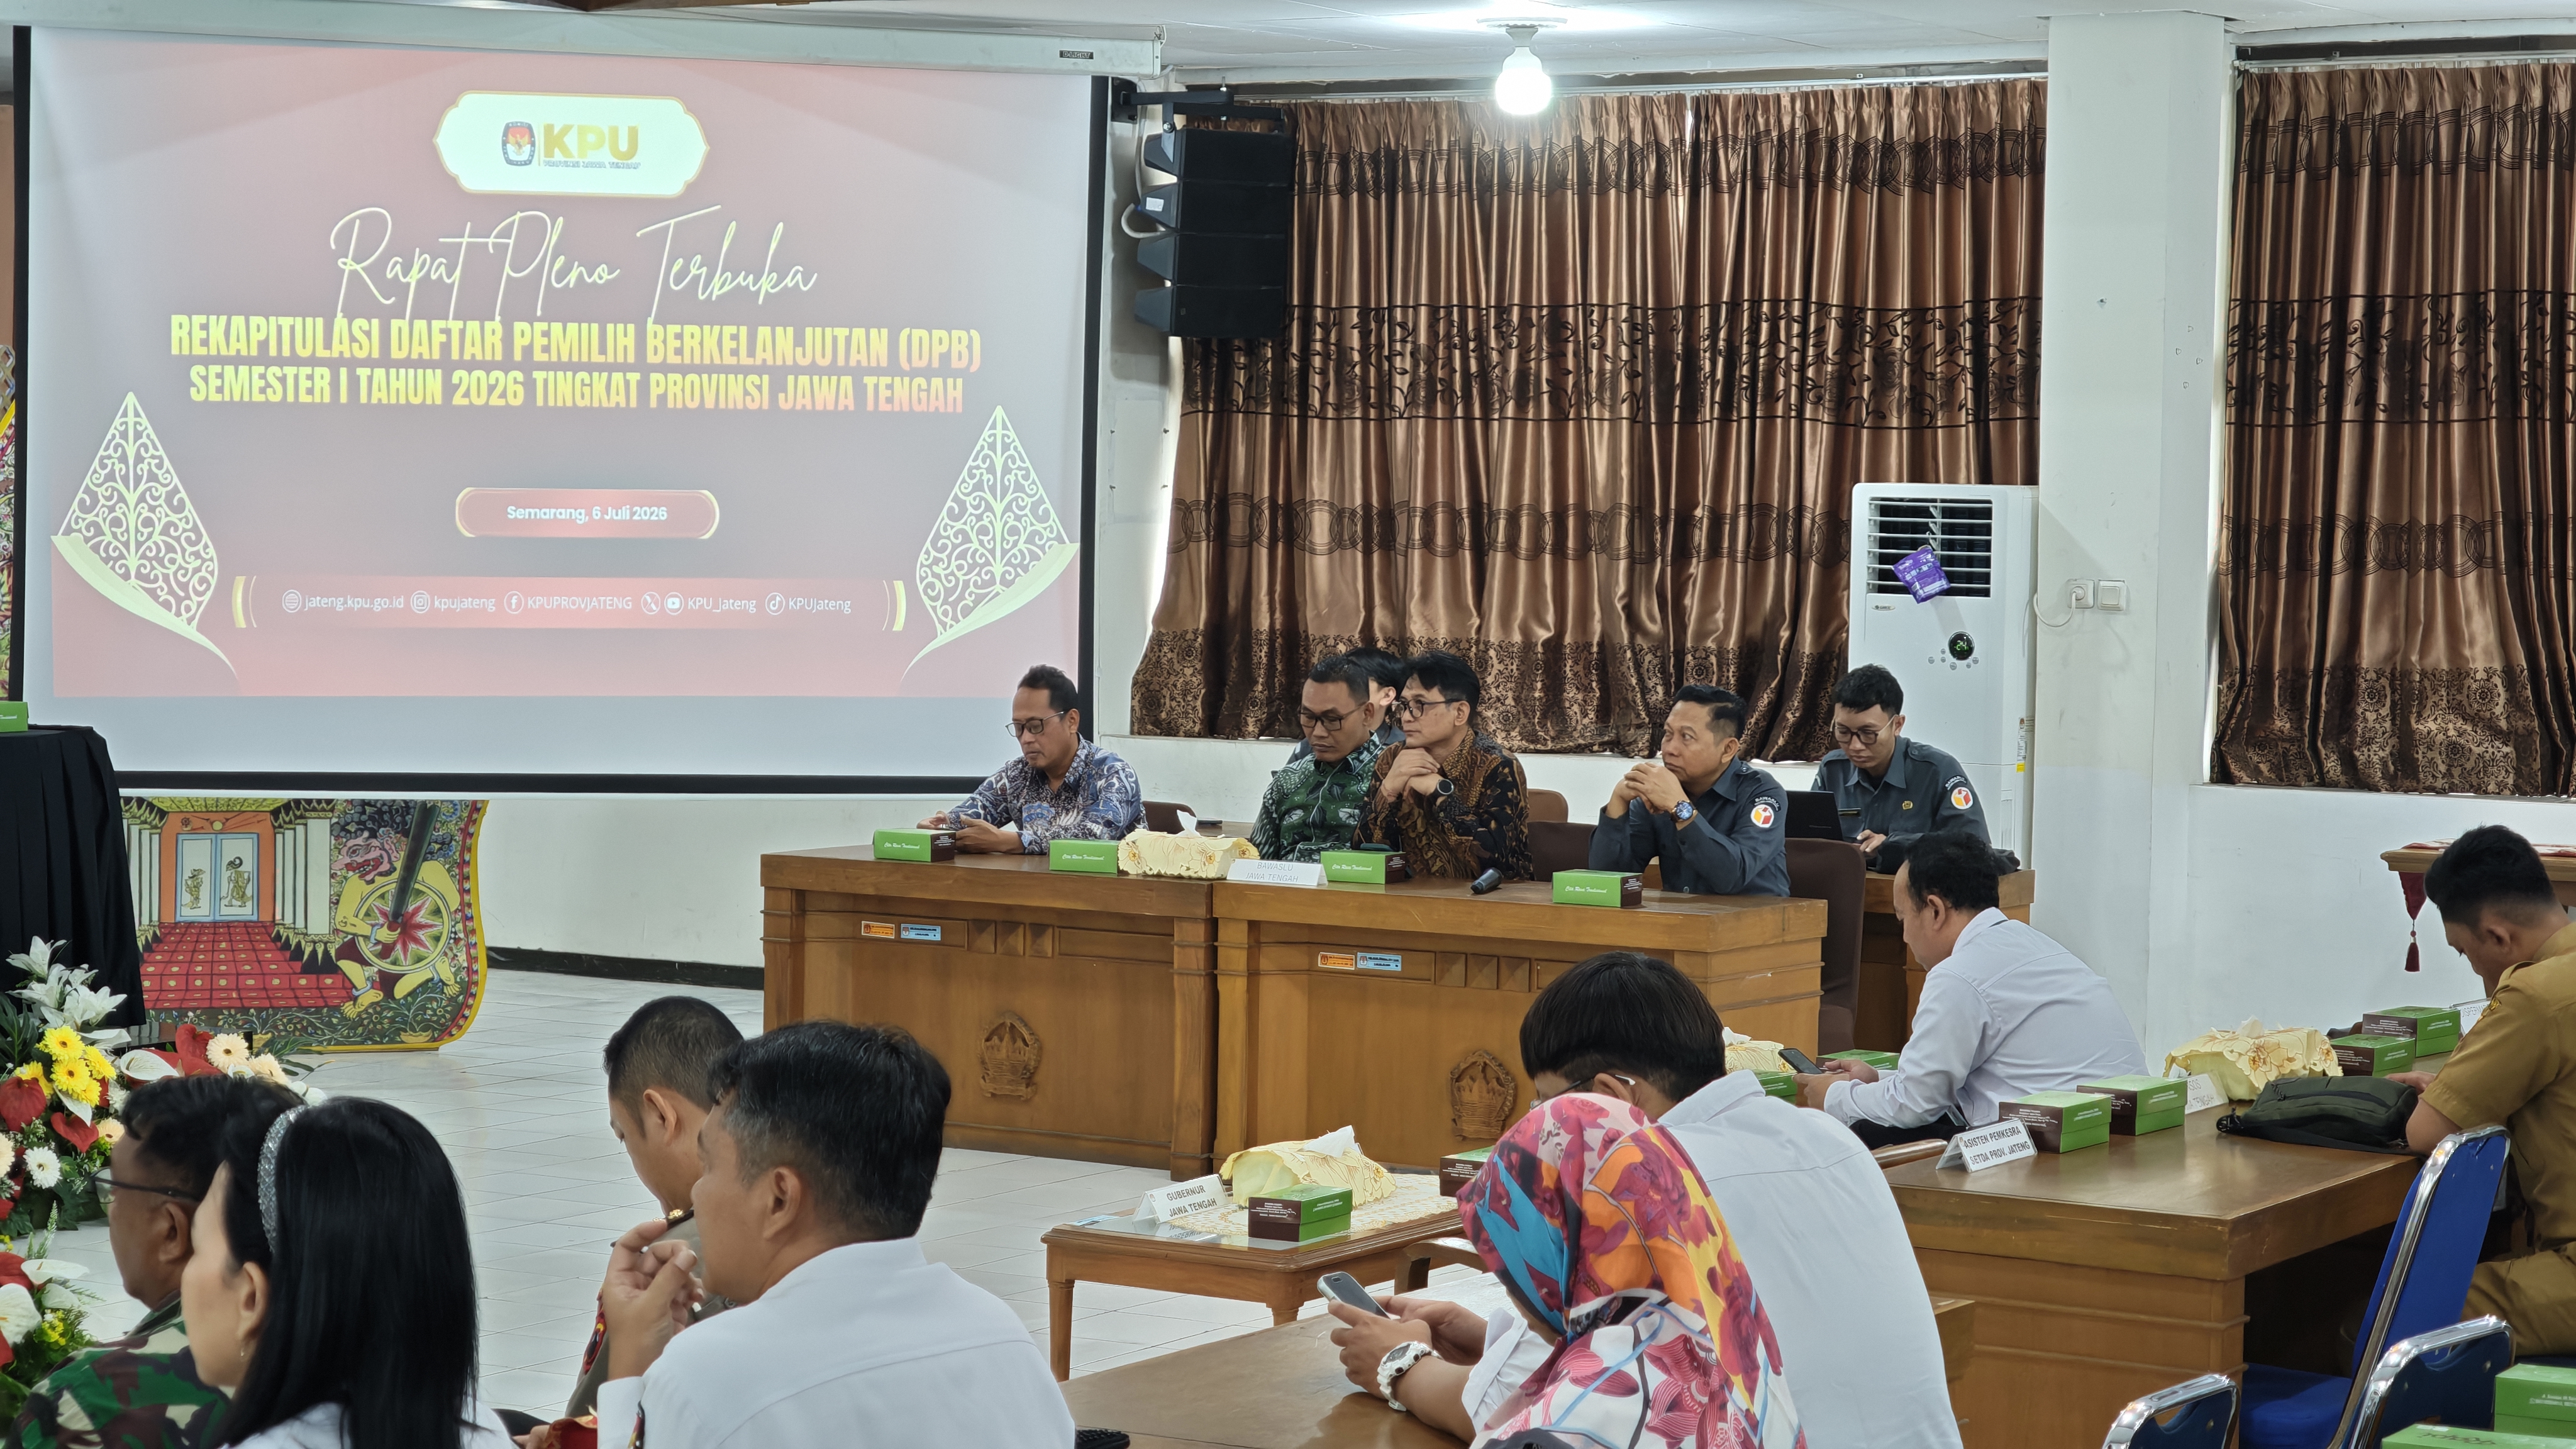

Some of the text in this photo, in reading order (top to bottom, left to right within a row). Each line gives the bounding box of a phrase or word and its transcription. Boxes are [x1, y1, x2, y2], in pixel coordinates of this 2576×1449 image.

[543, 123, 638, 161] KPU
[330, 204, 818, 328] Rapat Pleno Terbuka
[170, 314, 982, 372] REKAPITULASI DAFTAR PEMILIH BERKELANJUTAN (DPB)
[189, 364, 963, 413] SEMESTER I TAHUN 2026 TINGKAT PROVINSI JAWA TENGAH
[507, 505, 668, 524] Semarang, 6 Juli 2026
[304, 594, 852, 614] jateng.kpu.go.id kpujateng KPUPROVJATENG KPU_Jateng KPUJateng
[1257, 862, 1294, 871] BAWASLU
[1267, 874, 1299, 882] TENGAH
[1963, 1126, 2022, 1149] ASISTEN PEMKESRA
[1969, 1141, 2030, 1165] SETDA PROV. JATENG
[1167, 1185, 1206, 1201] GUBERNUR
[1169, 1197, 1218, 1217] JAWA TENGAH
